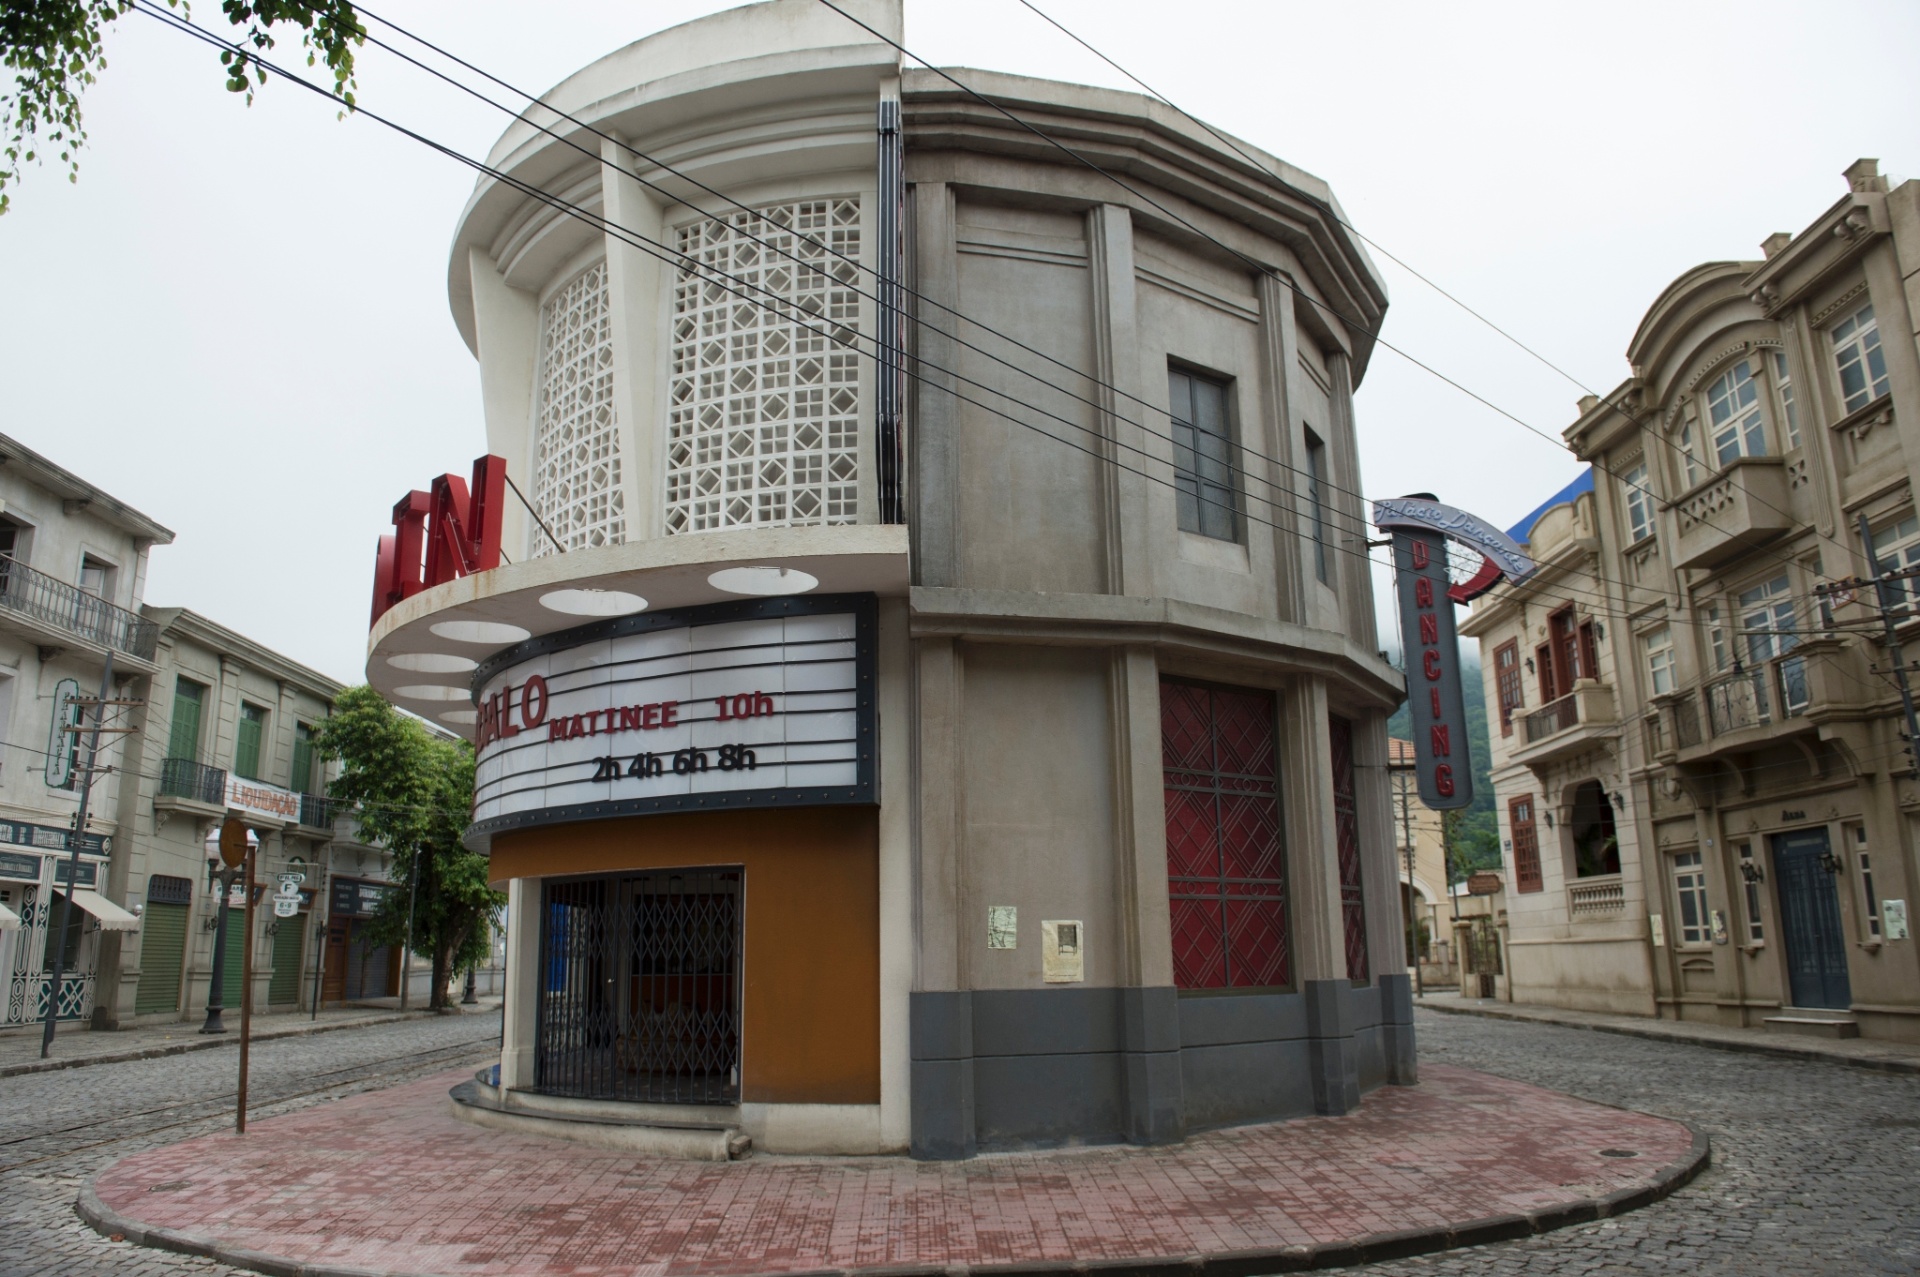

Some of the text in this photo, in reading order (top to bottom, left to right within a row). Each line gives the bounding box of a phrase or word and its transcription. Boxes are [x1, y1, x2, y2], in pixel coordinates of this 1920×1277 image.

[1375, 500, 1525, 573] Palácio Dançante
[1411, 539, 1454, 798] DANCING
[549, 690, 774, 743] MATINEE 10h
[591, 743, 756, 783] 2h 4h 6h 8h
[232, 781, 297, 817] LIQUIDAÇÃO
[284, 883, 292, 892] F
